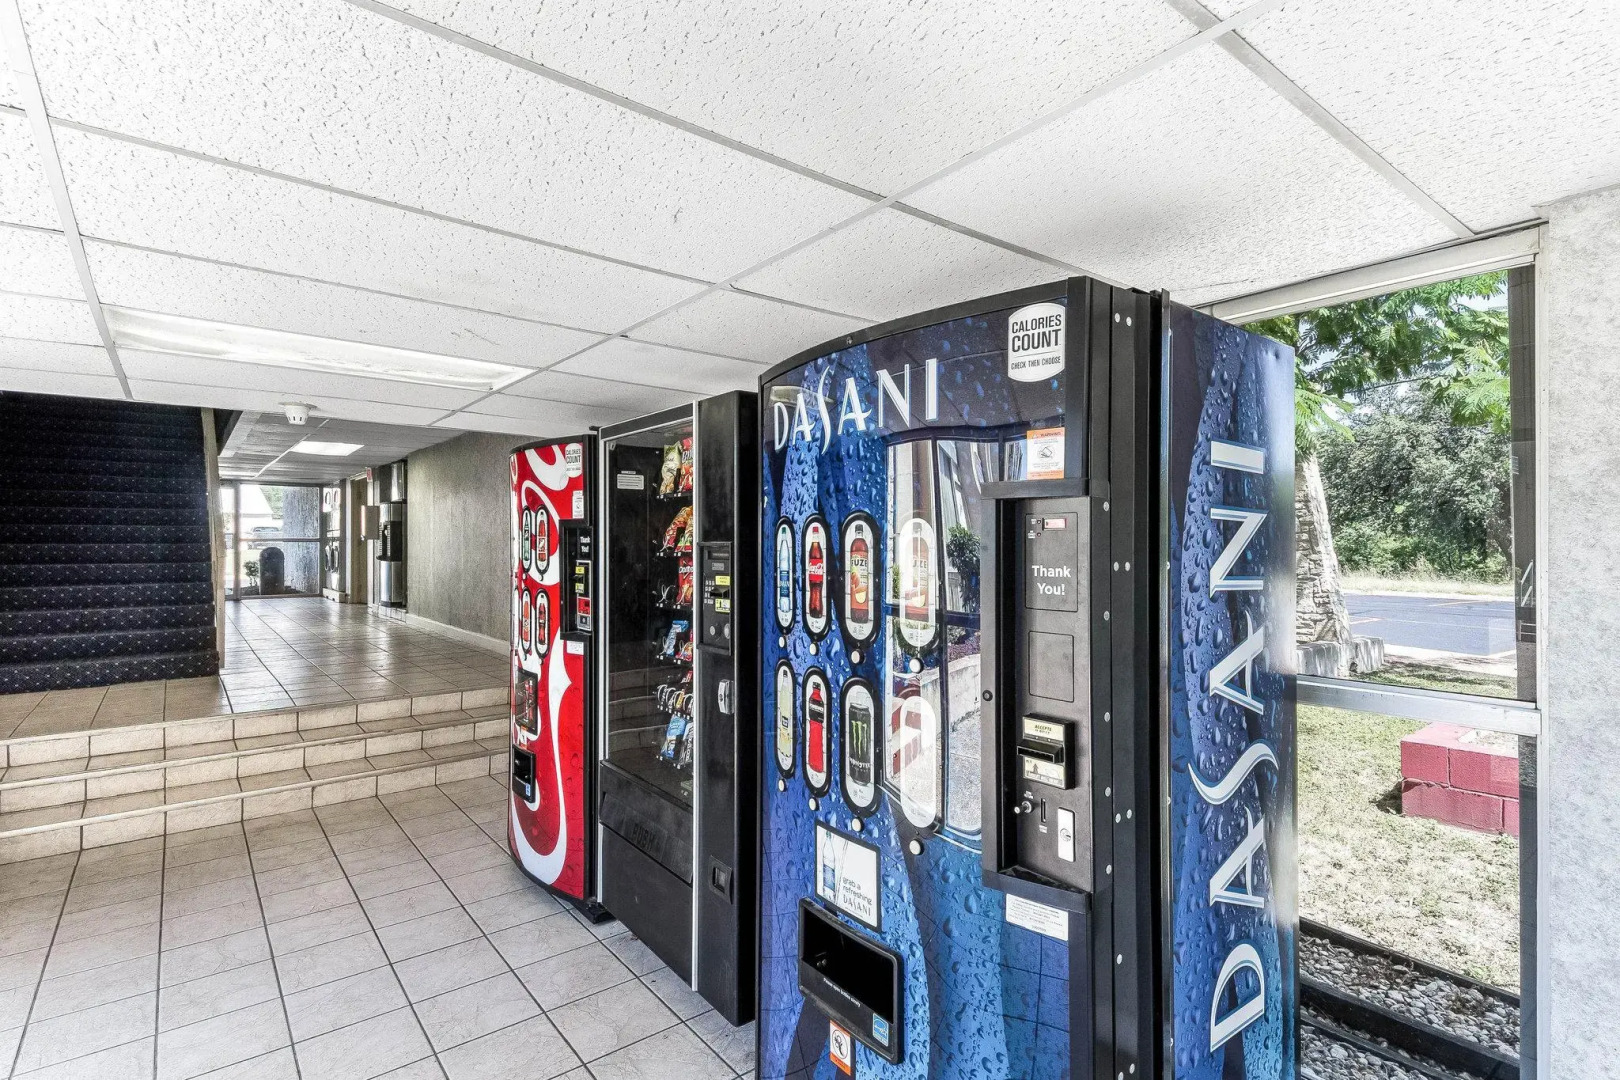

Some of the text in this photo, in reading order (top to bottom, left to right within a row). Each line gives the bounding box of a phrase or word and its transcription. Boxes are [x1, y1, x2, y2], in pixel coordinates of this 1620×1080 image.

[1011, 313, 1062, 334] CALORIES
[1011, 328, 1062, 353] COUNT
[1010, 355, 1062, 371] CHECK THEN CHOOSE
[773, 358, 939, 456] DASANI
[566, 455, 581, 465] COUNT
[1031, 565, 1072, 578] Thank
[1036, 582, 1066, 596] You!
[1187, 440, 1280, 1055] DASANI
[842, 877, 856, 888] grab
[842, 886, 872, 906] refreshing
